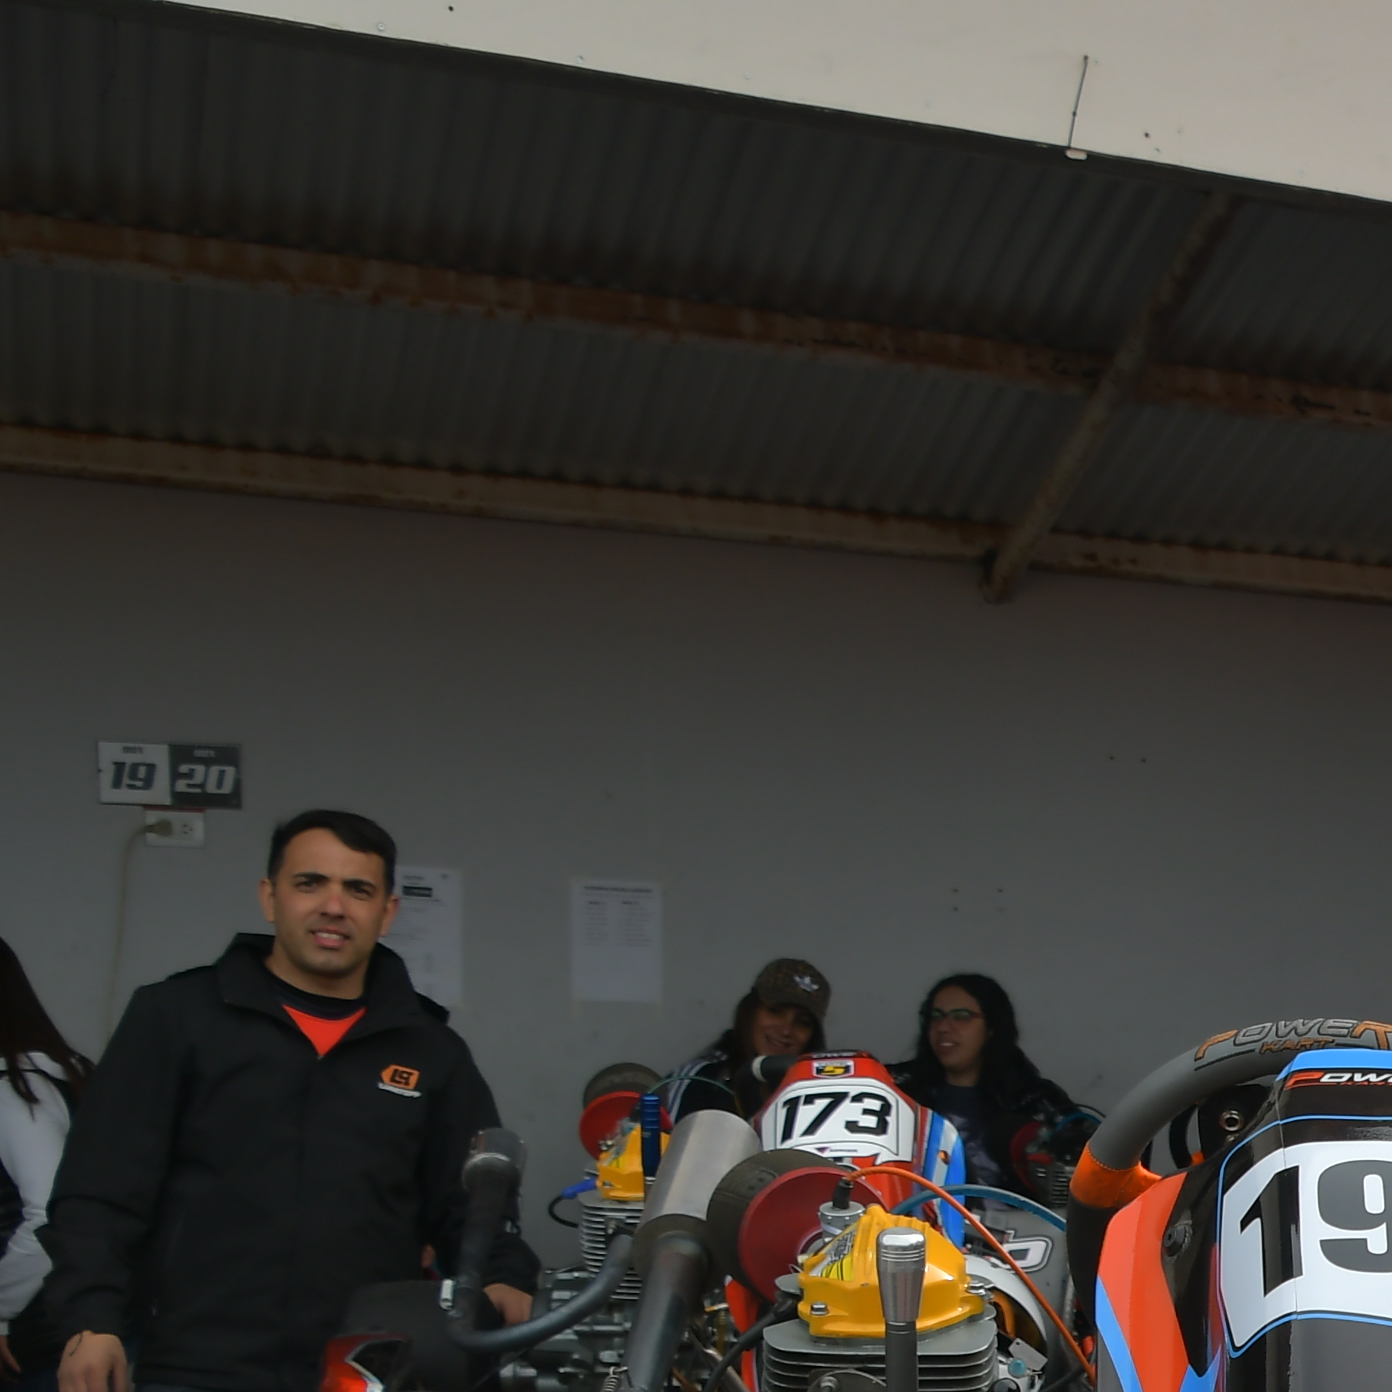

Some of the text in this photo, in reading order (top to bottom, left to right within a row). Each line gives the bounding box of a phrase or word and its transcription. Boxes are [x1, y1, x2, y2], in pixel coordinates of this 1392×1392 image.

[110, 761, 157, 791] 19
[174, 764, 237, 795] 20
[1259, 1037, 1335, 1054] KART
[781, 1091, 893, 1145] 173
